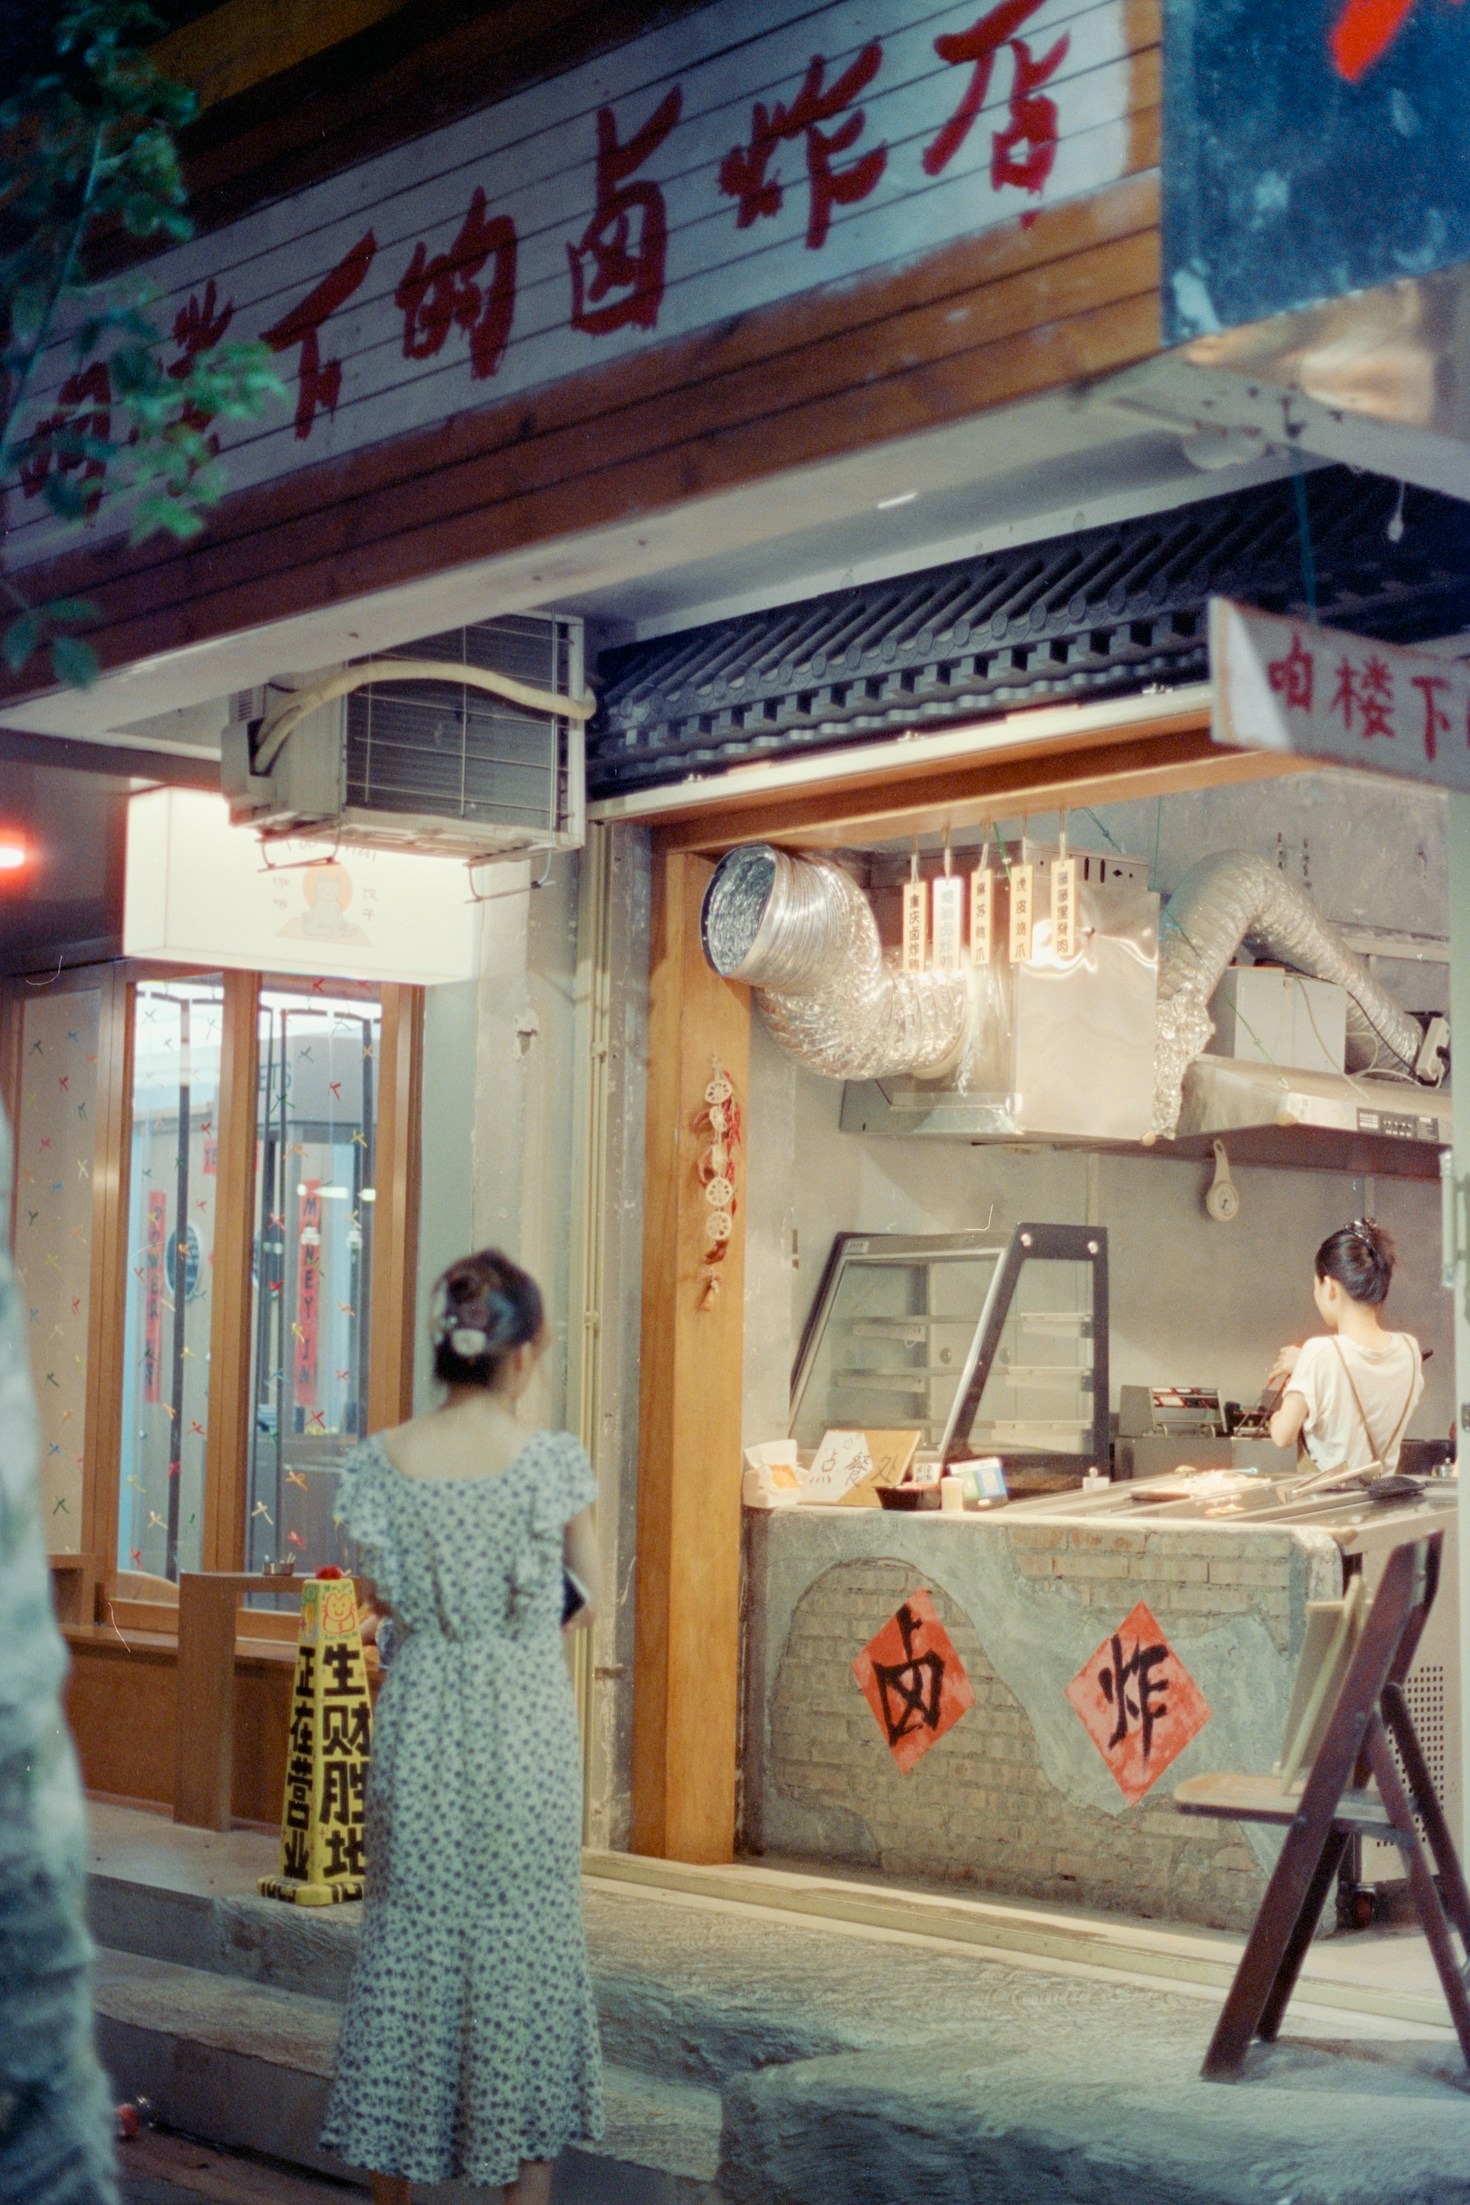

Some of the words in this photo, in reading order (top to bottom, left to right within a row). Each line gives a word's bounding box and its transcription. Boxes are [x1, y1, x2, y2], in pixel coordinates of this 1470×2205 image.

[1266, 632, 1470, 762] 咱楼下
[303, 1198, 318, 1319] MNEY
[873, 1604, 945, 1747] 卤
[1098, 1633, 1169, 1766] 炸
[284, 1646, 315, 1881] 正在营业
[319, 1643, 372, 1878] 生财胜地
